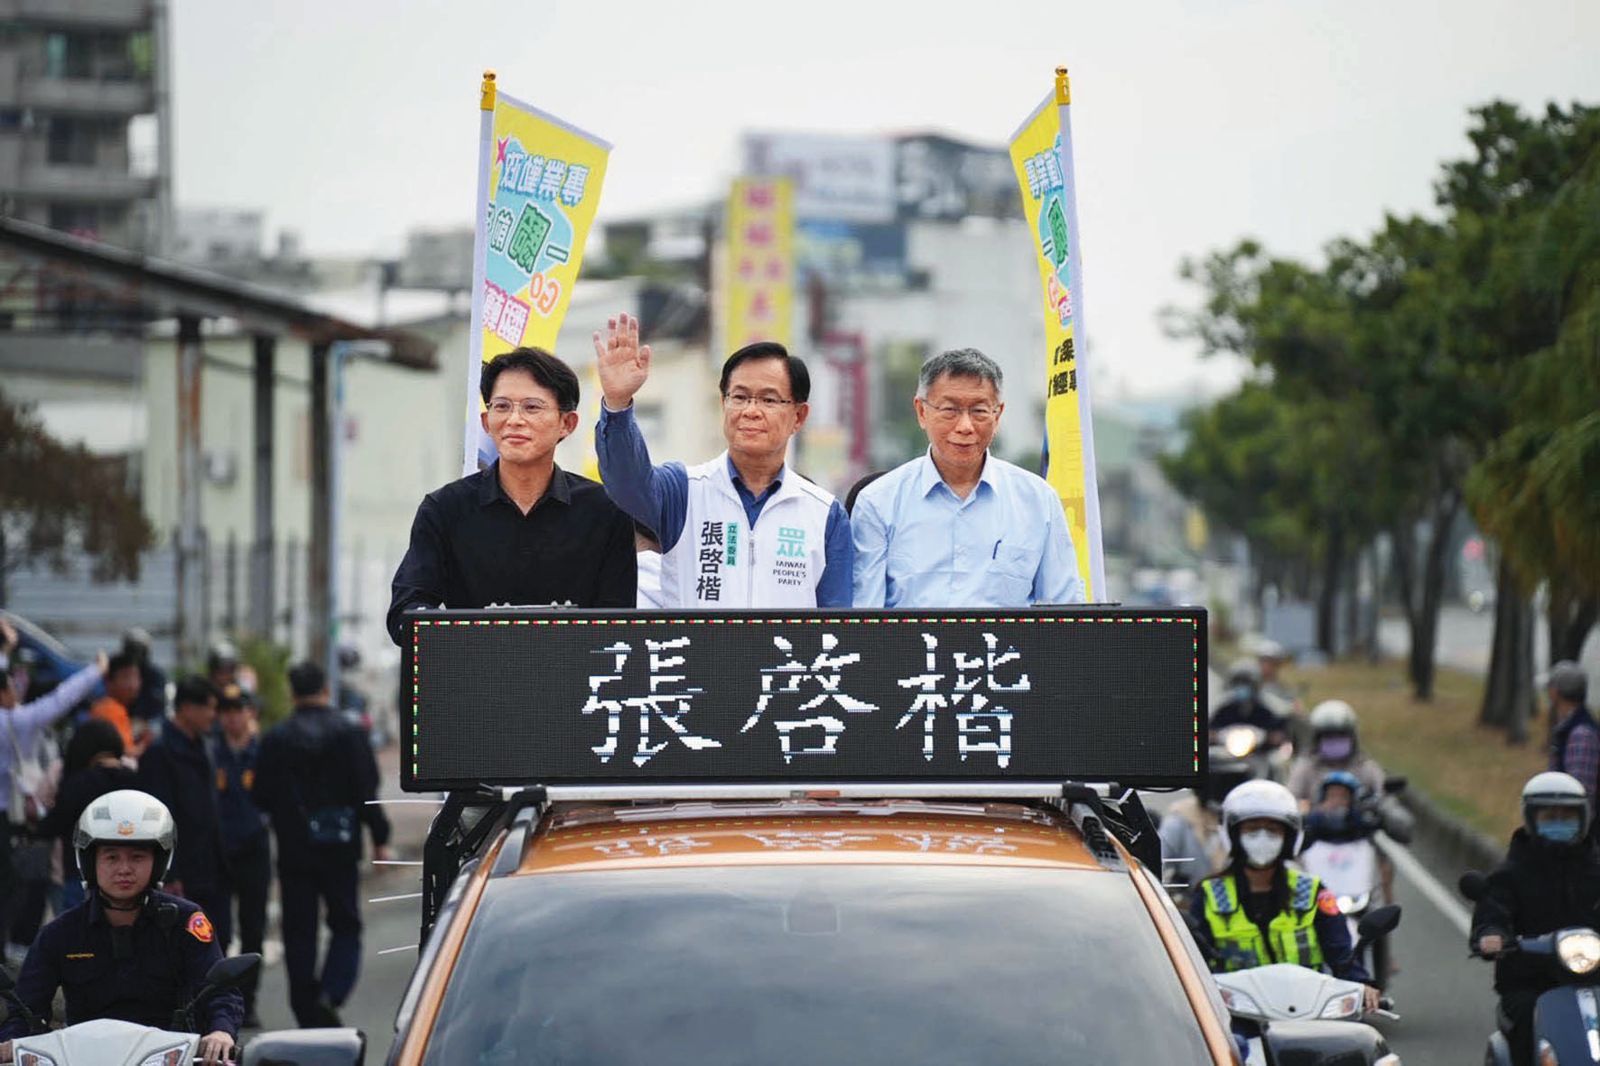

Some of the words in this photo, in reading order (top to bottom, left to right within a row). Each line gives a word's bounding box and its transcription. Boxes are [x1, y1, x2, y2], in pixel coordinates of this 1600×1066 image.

[727, 525, 738, 566] 立法委員
[775, 560, 807, 569] TAIWAN
[772, 568, 807, 579] PEOPLE'S
[777, 578, 803, 586] PARTY
